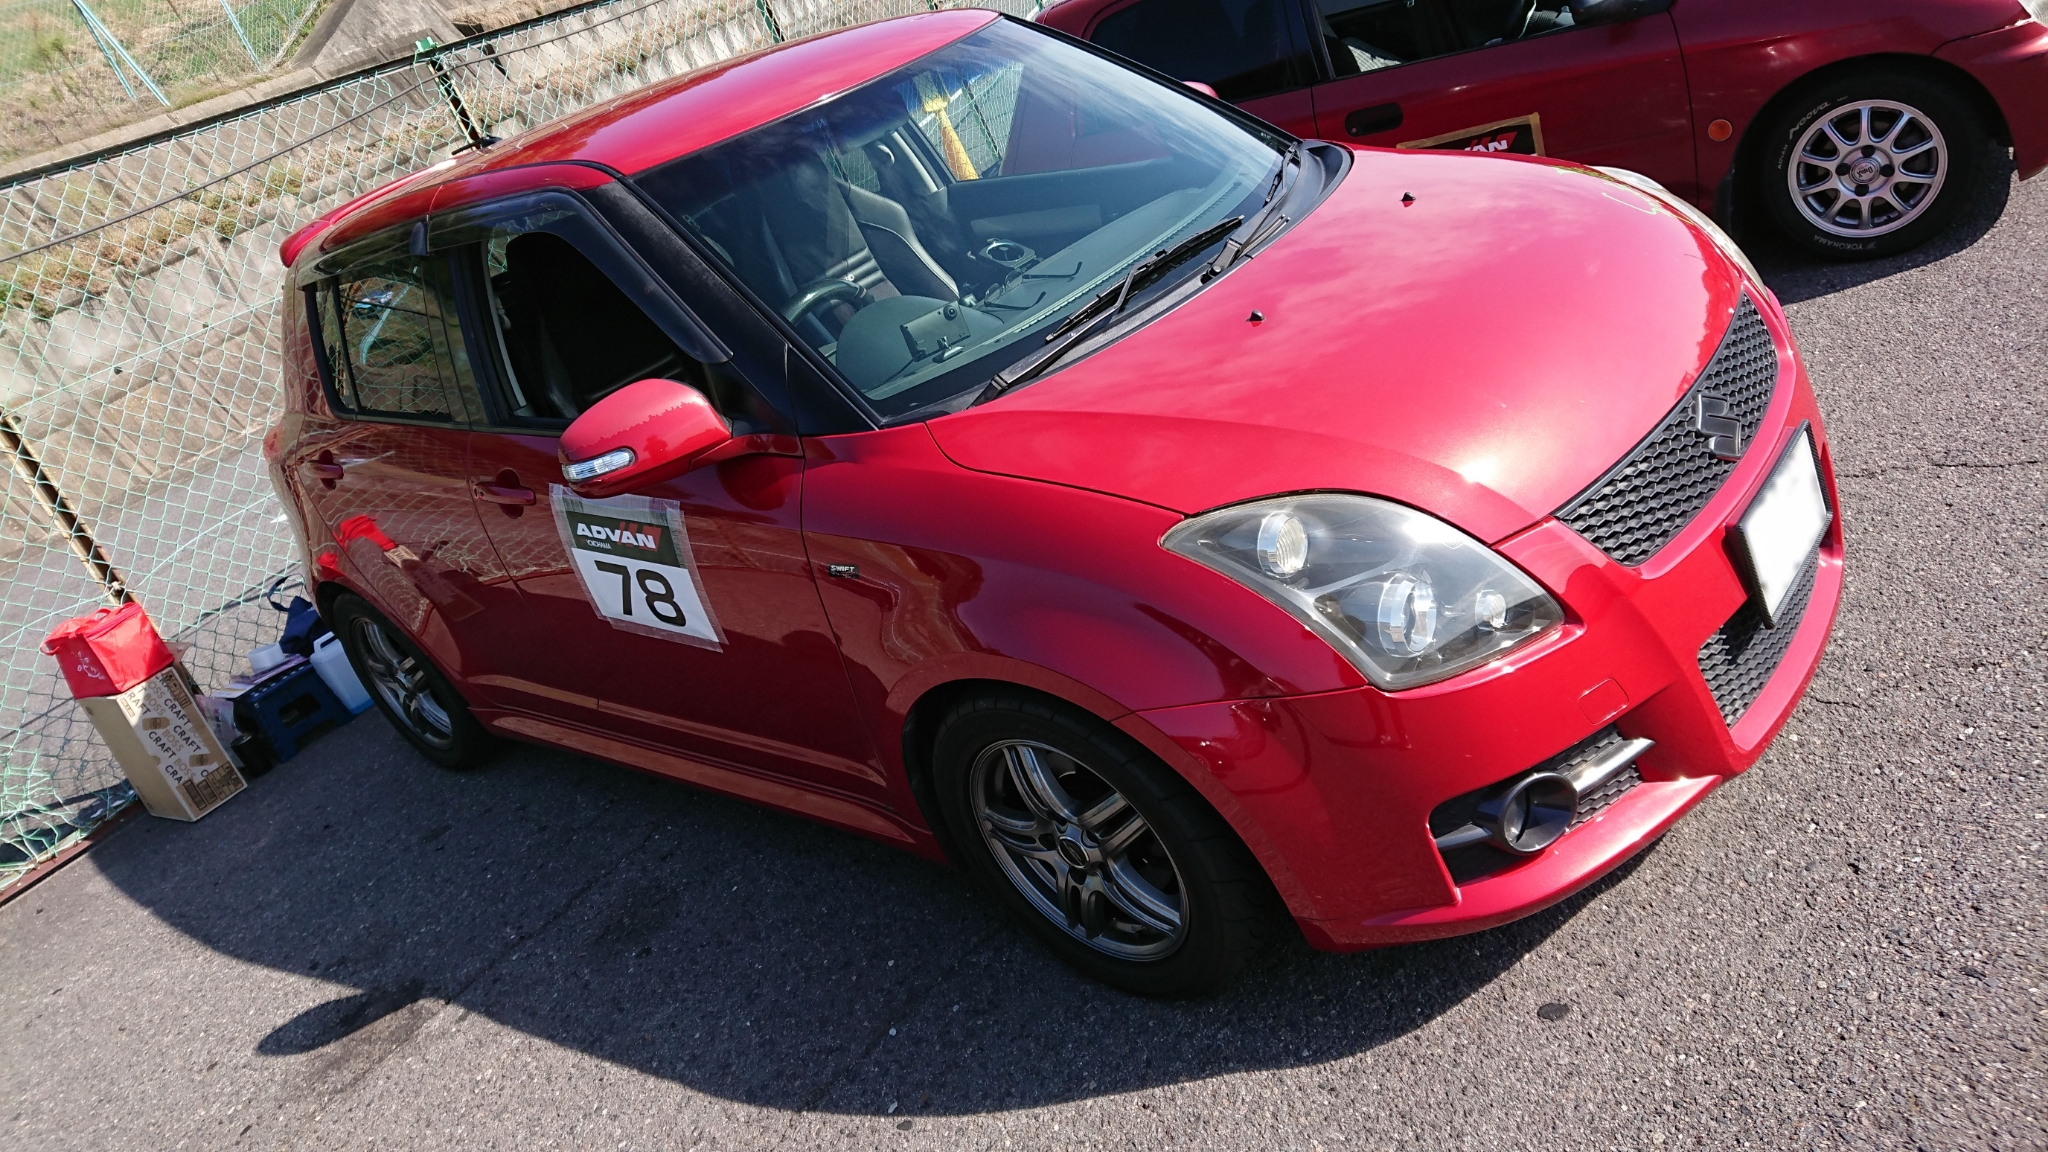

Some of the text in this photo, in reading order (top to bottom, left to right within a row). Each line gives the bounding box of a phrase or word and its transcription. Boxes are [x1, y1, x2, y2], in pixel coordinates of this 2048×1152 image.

[1464, 140, 1508, 152] AN
[1777, 144, 1788, 170] ADVAN
[1814, 235, 1863, 250] YOKOHAMA
[576, 522, 657, 549] ADVAN
[594, 560, 686, 627] 78
[164, 699, 191, 726] CRAFT
[148, 731, 177, 758] CRAFT
[162, 729, 184, 751] BOSS
[173, 725, 202, 752] CRAFT
